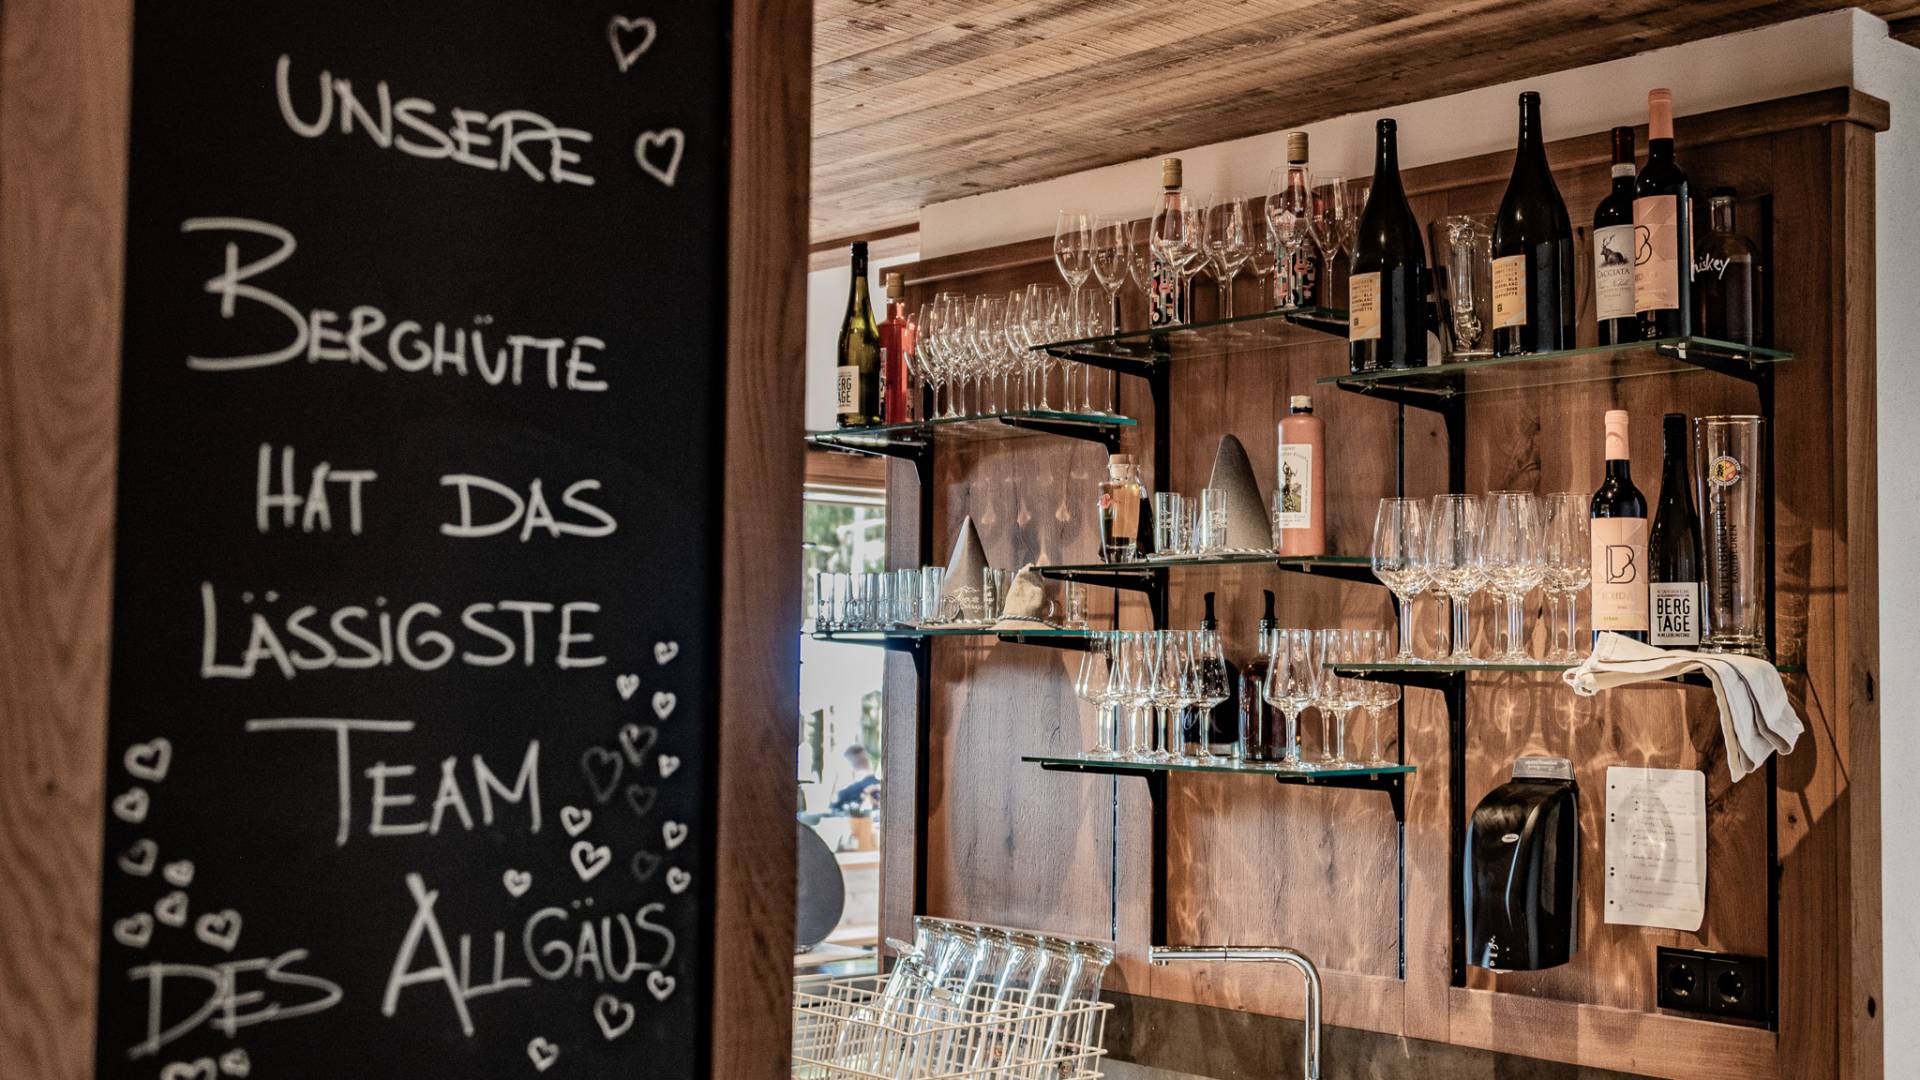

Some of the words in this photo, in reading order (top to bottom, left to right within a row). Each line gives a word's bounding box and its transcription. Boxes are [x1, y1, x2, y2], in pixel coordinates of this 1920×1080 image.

[276, 53, 596, 186] UNSERE
[181, 216, 609, 392] BERGHÜTTE
[1690, 252, 1731, 283] hiskey
[256, 442, 377, 534] HAT
[440, 473, 618, 543] DAS
[1656, 598, 1691, 615] BERG
[1656, 615, 1691, 633] TAGE
[244, 717, 542, 847] TEAM
[128, 948, 343, 1060] DES
[381, 872, 676, 1038] ALLGÄUS
